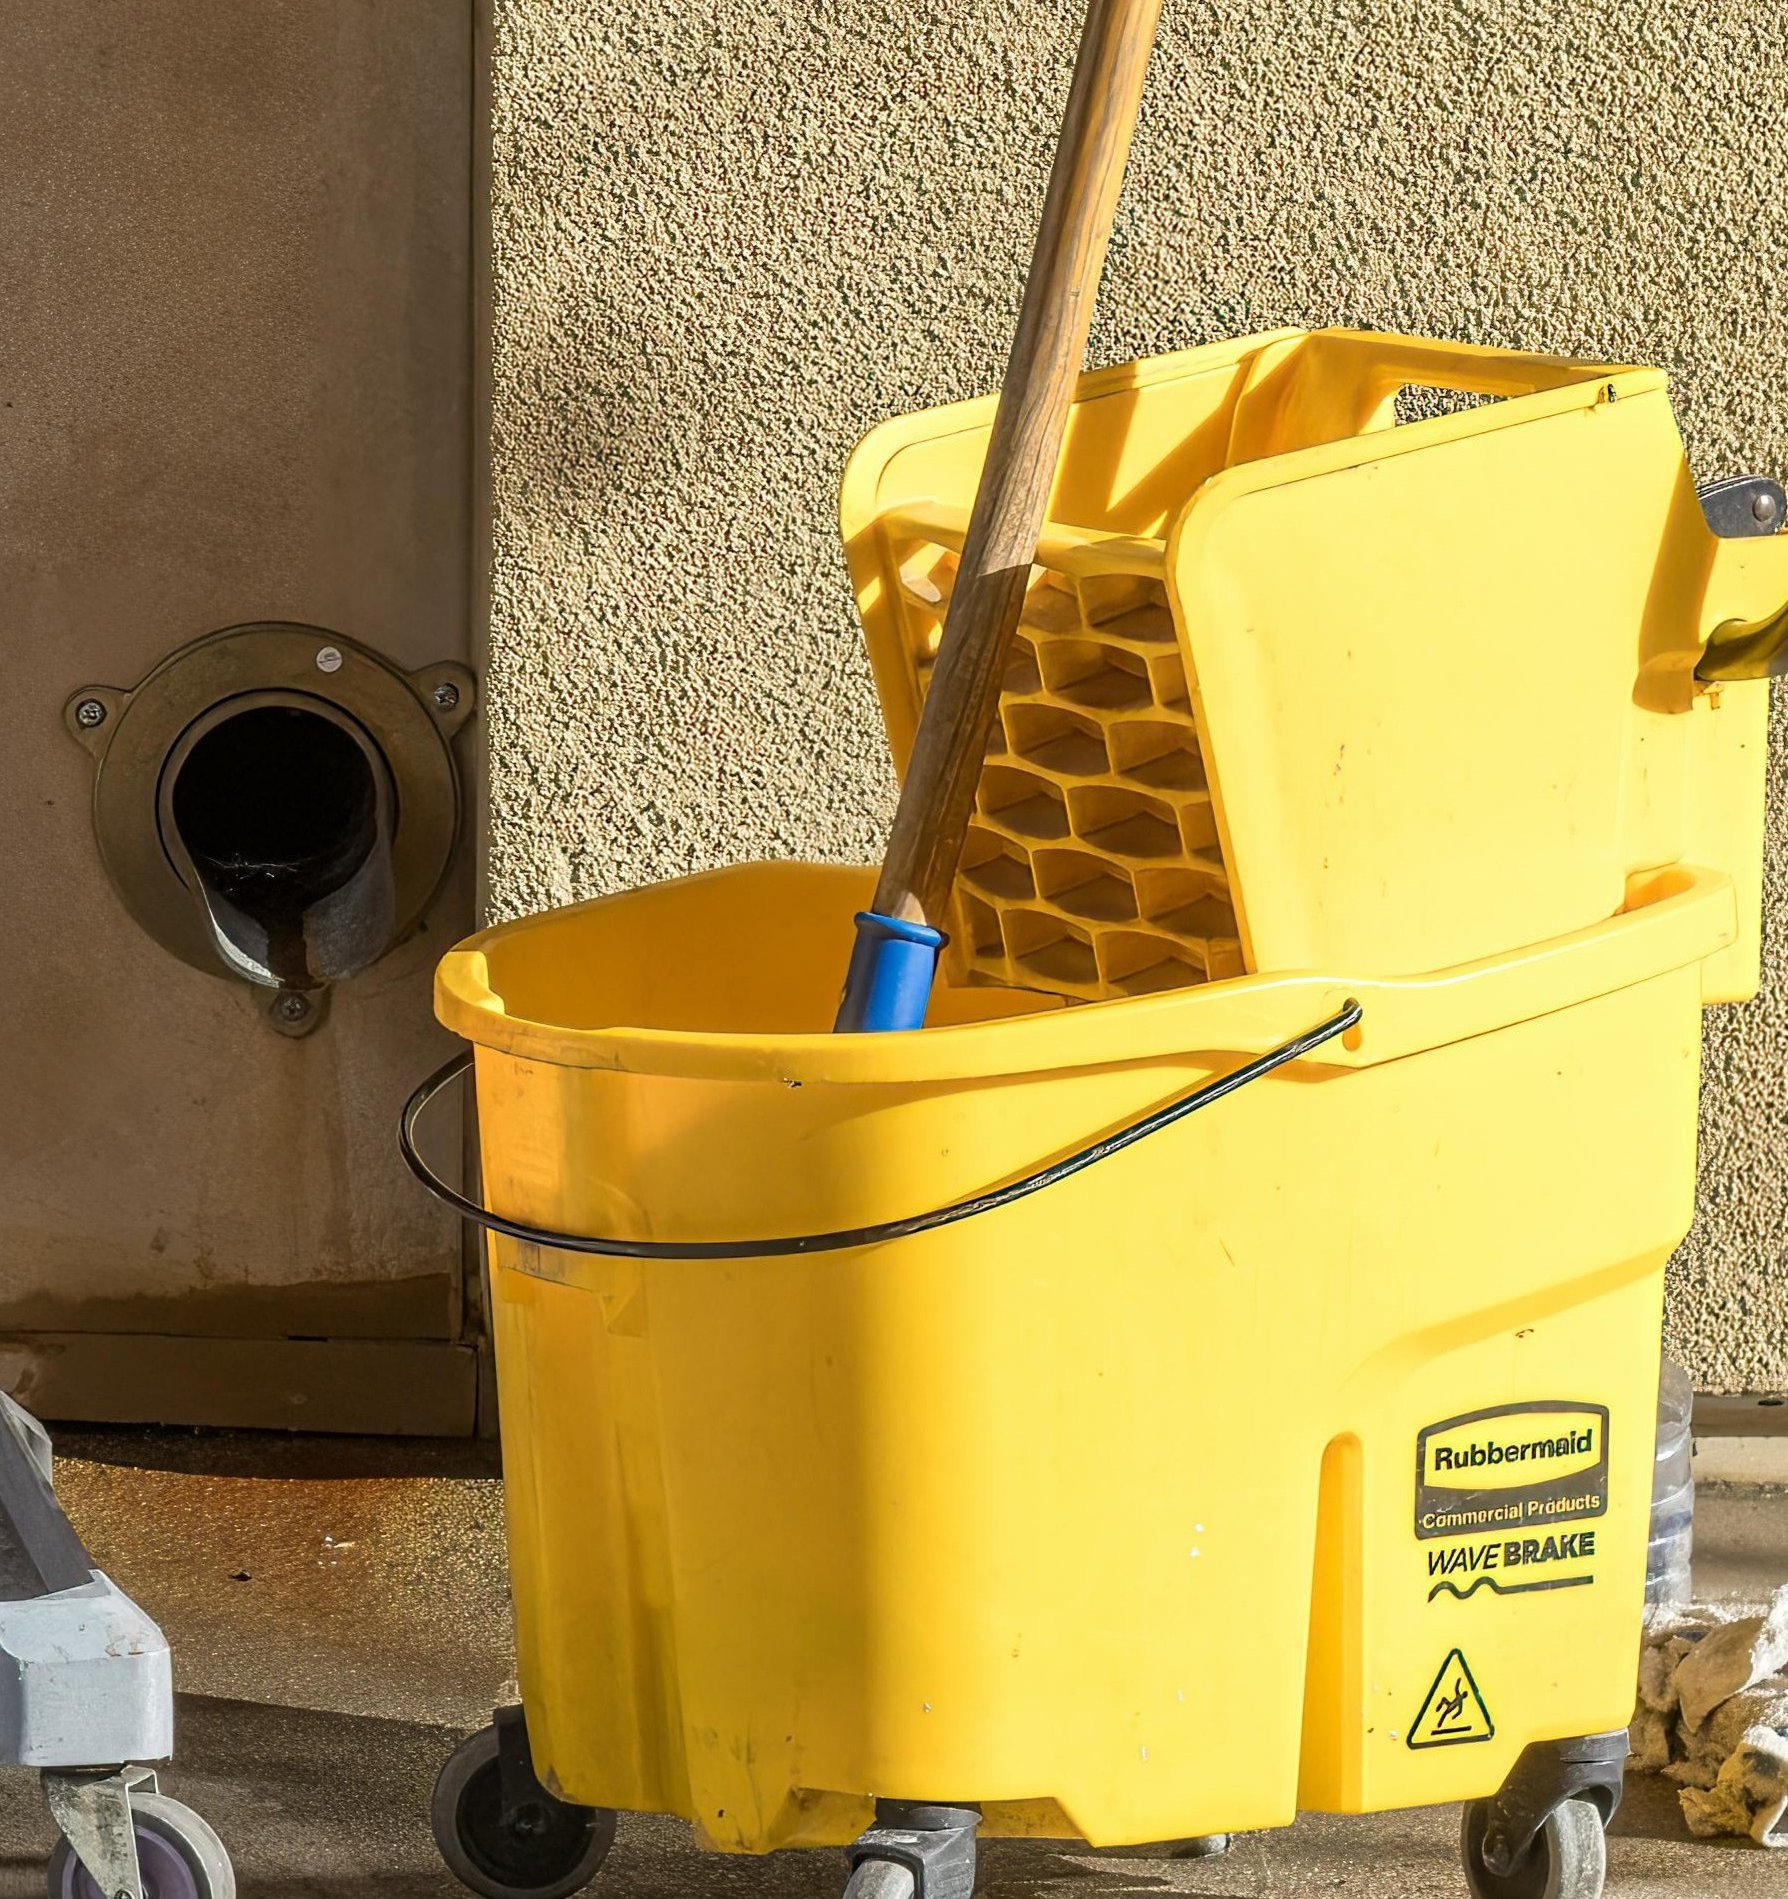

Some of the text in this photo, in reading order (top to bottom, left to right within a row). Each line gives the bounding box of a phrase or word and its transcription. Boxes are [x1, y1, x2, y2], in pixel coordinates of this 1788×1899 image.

[1434, 1428, 1593, 1471] Rubbermaid
[1422, 1494, 1601, 1529] Commercial Products
